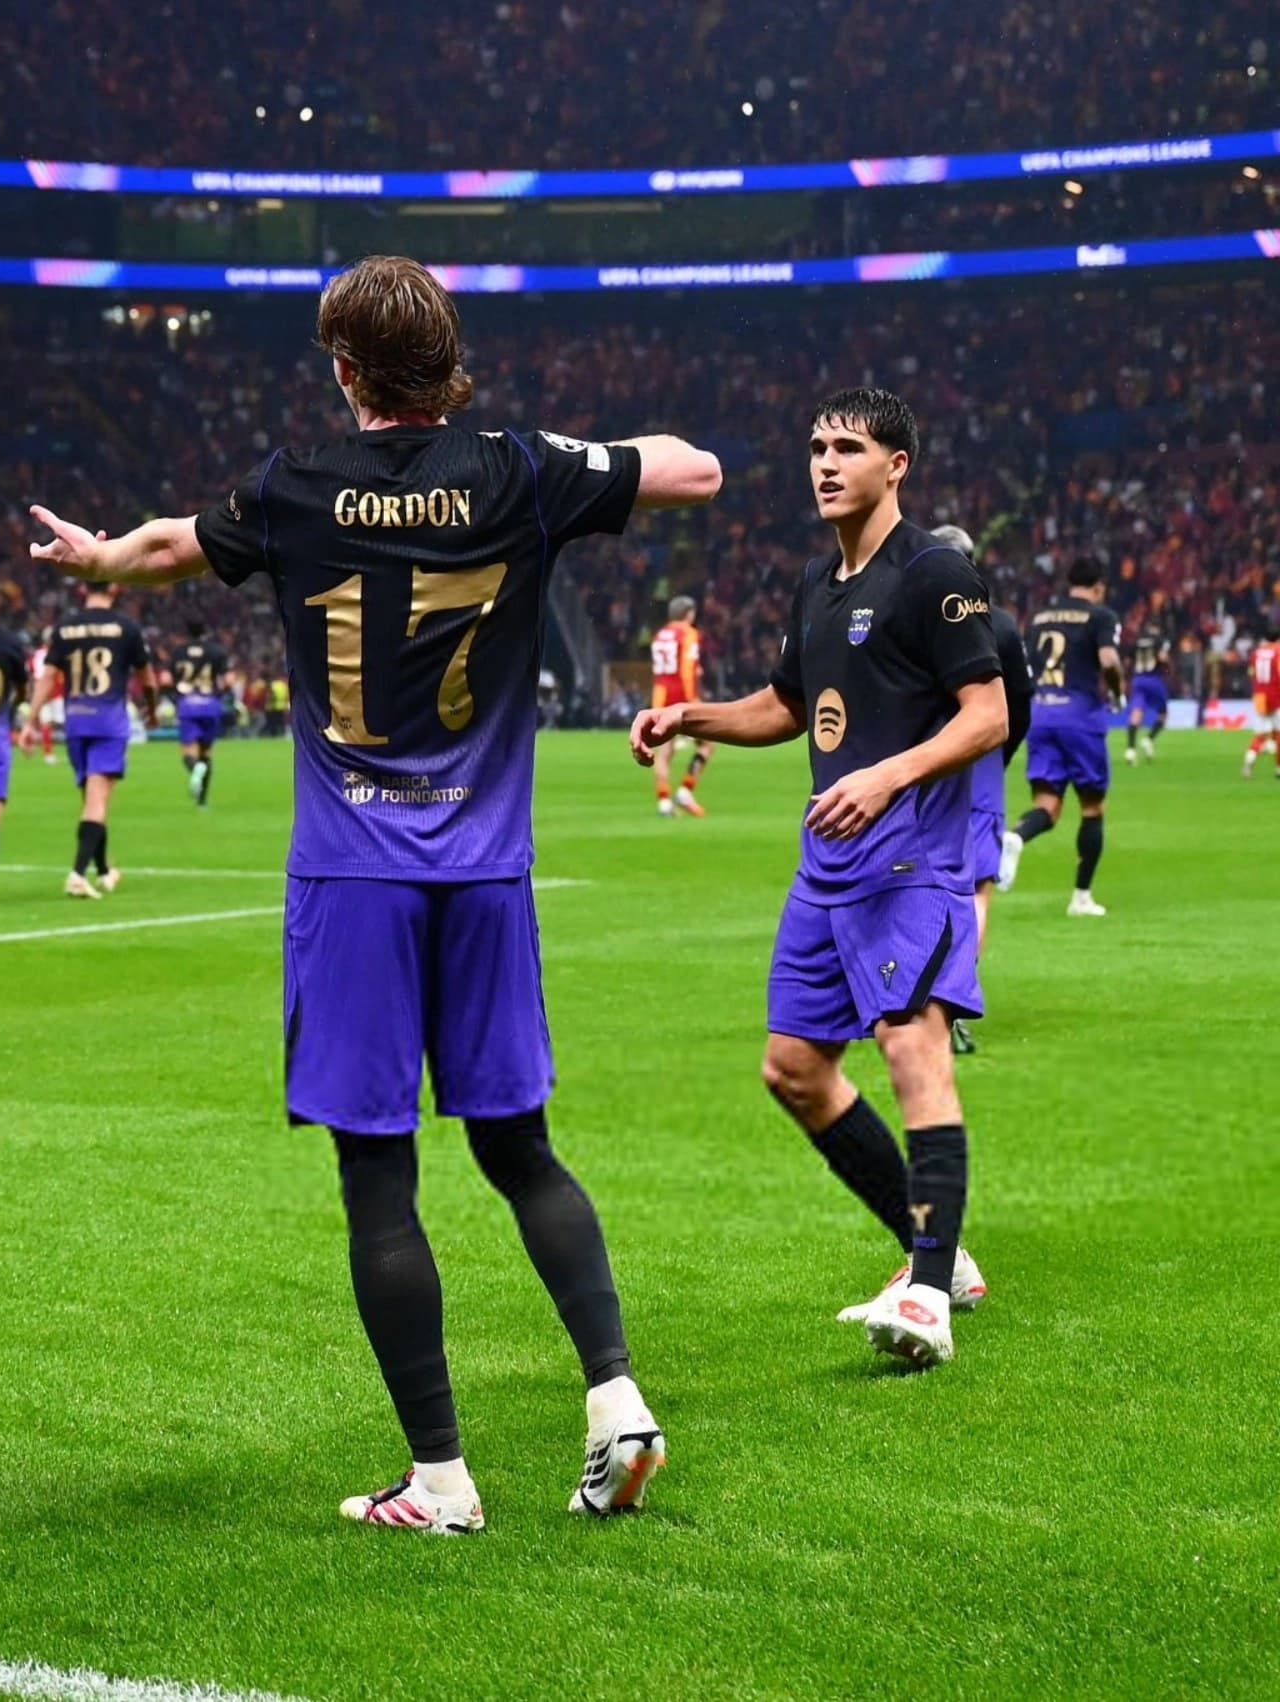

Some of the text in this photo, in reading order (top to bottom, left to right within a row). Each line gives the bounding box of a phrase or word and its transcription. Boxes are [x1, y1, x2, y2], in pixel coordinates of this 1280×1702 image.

[1021, 139, 1211, 171] UEFA CHAMPIONS LEAGUE
[192, 172, 382, 194] UEFA CHAMPIONS LEAGUE
[598, 263, 793, 286] UEFA CHAMPIONS LEAGUE
[334, 488, 471, 527] GORDON
[305, 562, 508, 745] 17
[1037, 630, 1066, 688] 2
[67, 646, 112, 697] 18
[176, 661, 212, 694] 24
[381, 787, 472, 804] FOUNDATION
